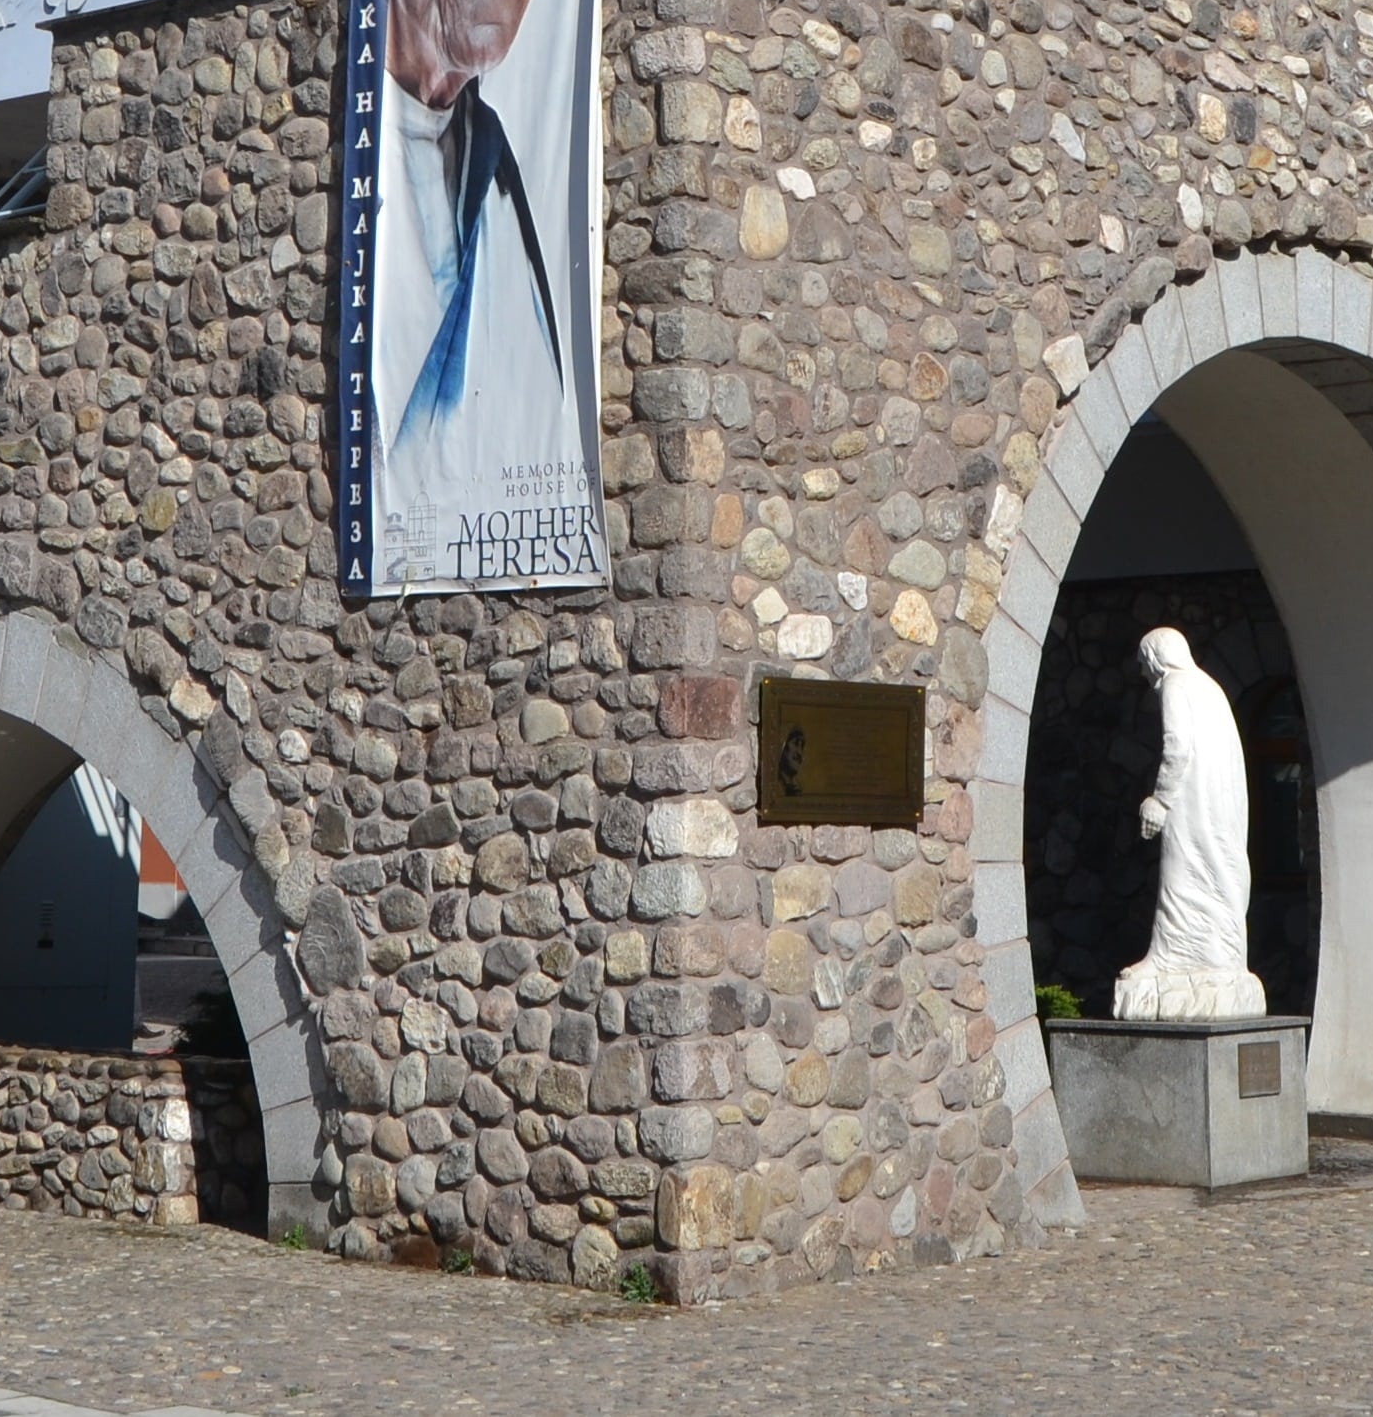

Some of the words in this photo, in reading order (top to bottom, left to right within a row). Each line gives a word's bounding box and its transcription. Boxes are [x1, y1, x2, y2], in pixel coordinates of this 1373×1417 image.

[354, 91, 374, 149] НА
[350, 176, 372, 343] МАЈКА
[348, 372, 365, 580] ТЕРЕЗА
[501, 461, 596, 480] MEMORIAL
[505, 480, 566, 498] HOUSE
[577, 477, 596, 493] OF
[459, 504, 600, 544] MOTHER
[446, 533, 602, 580] TERESA
